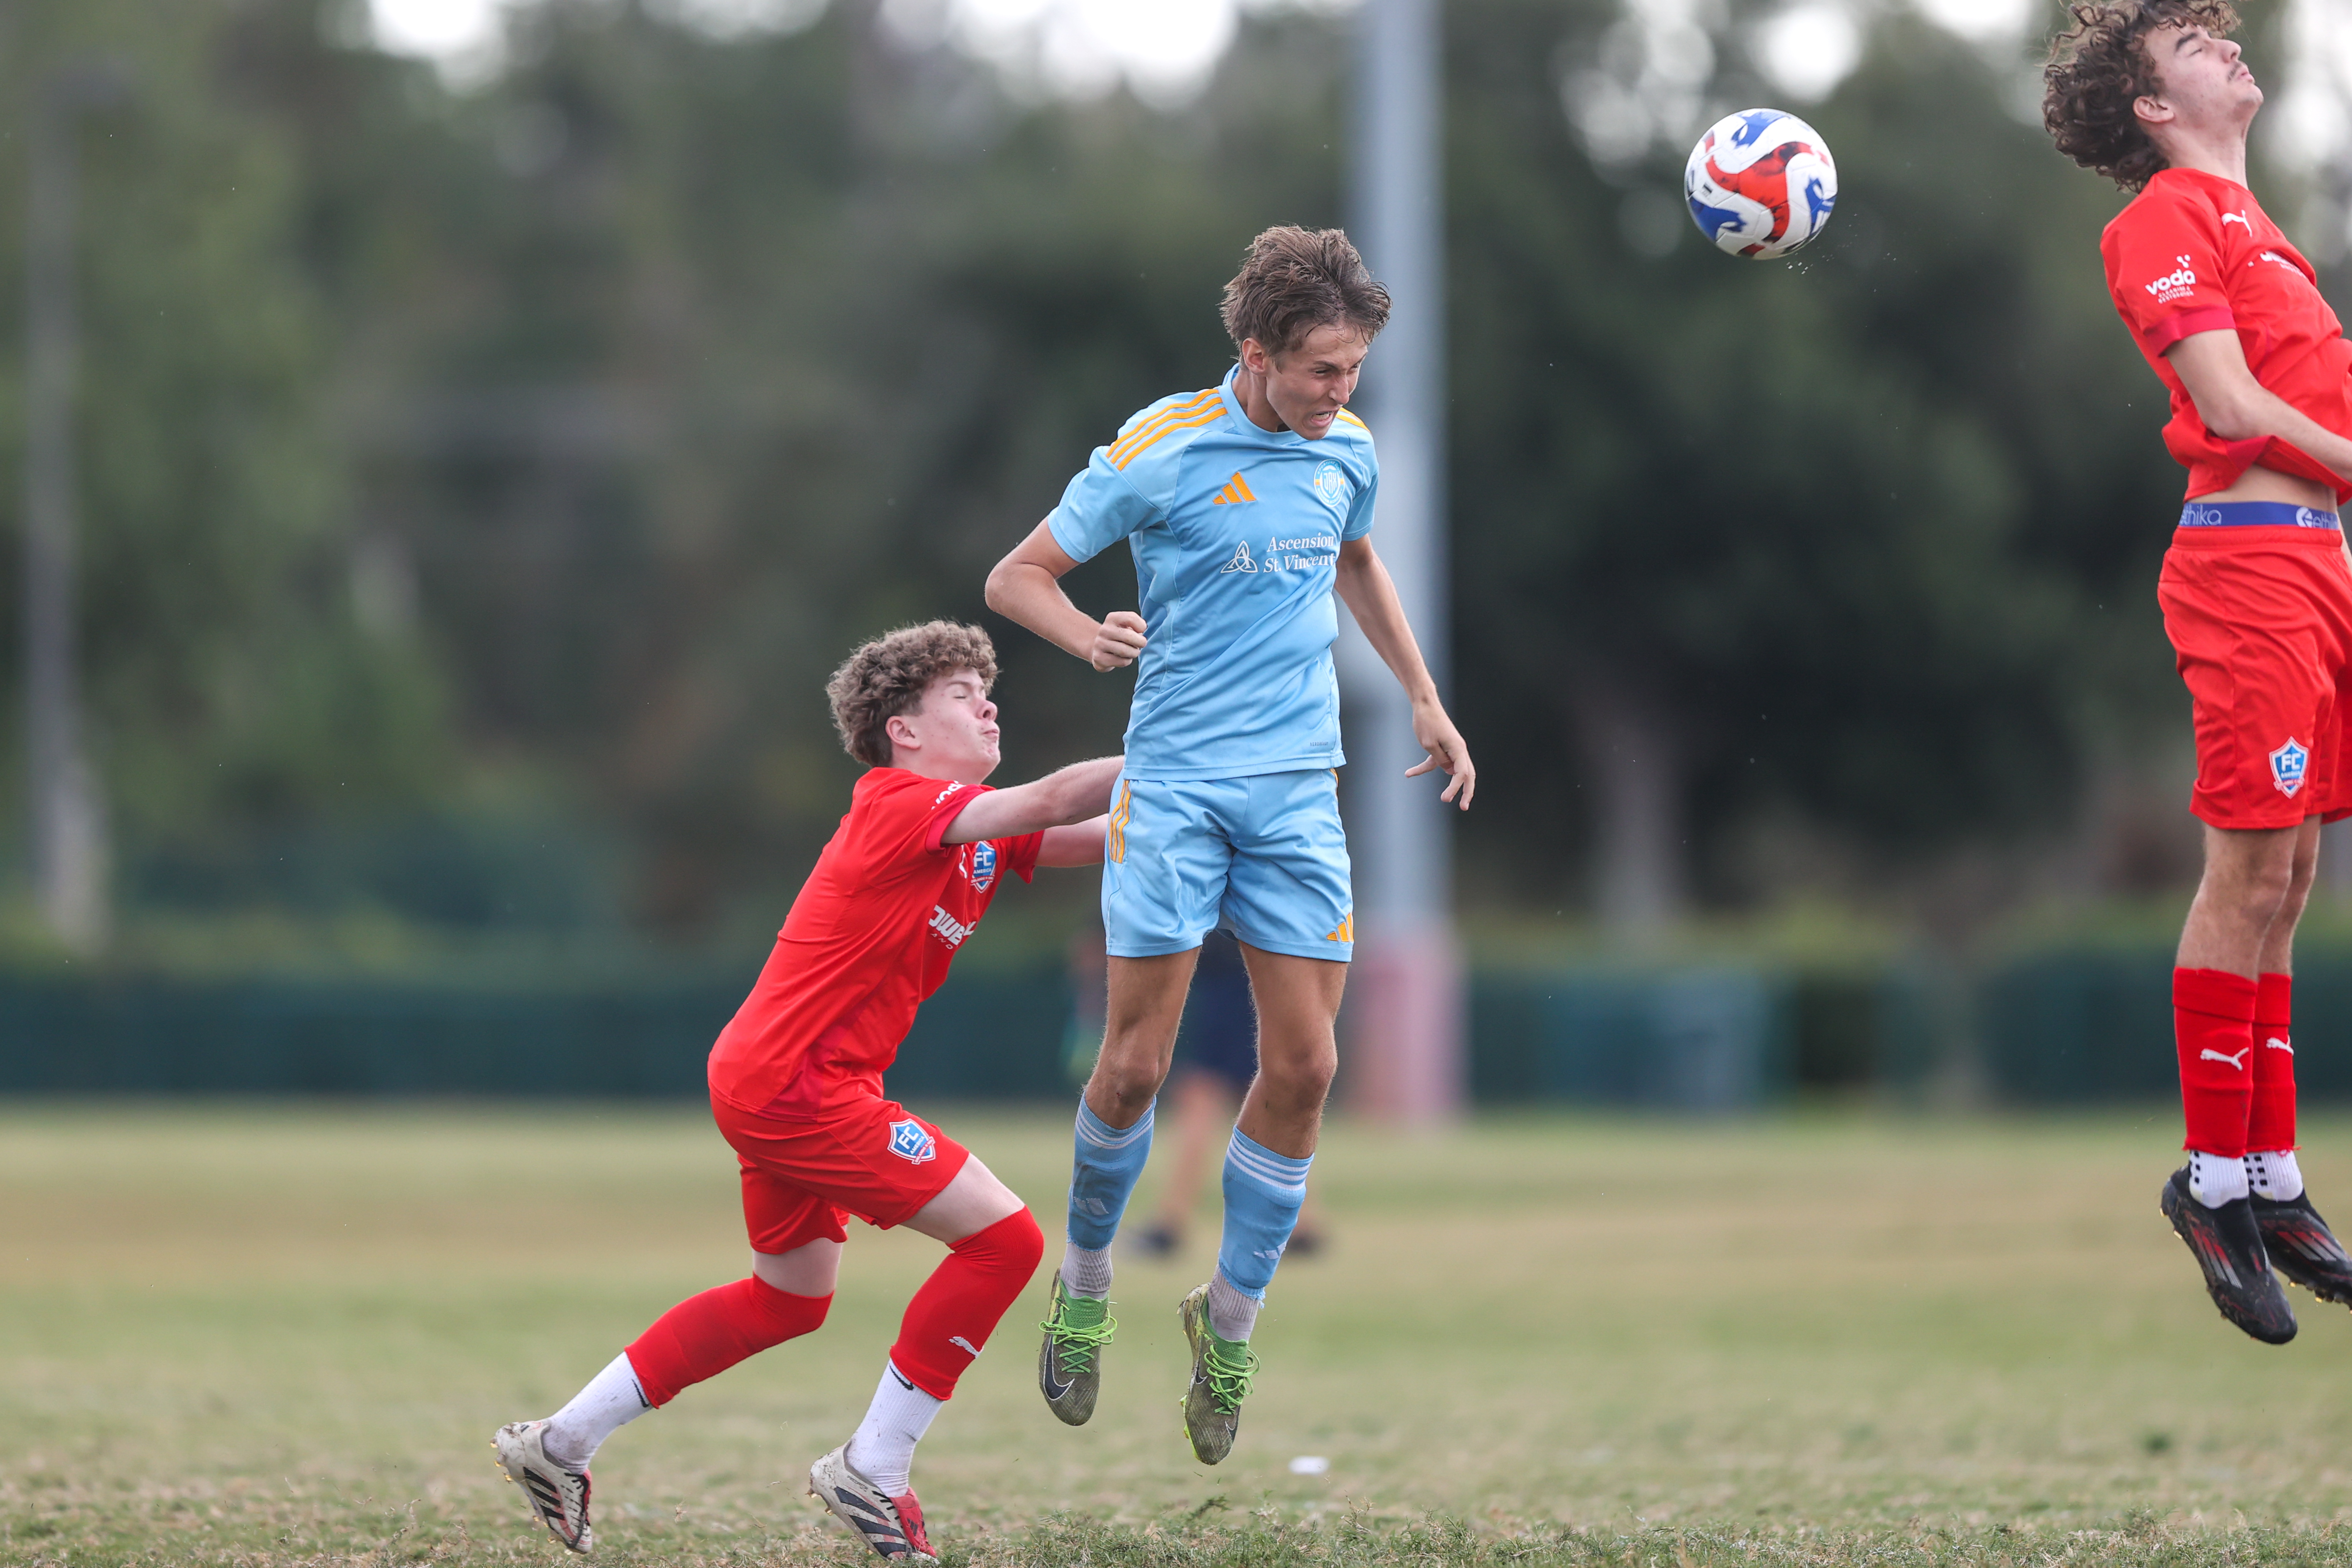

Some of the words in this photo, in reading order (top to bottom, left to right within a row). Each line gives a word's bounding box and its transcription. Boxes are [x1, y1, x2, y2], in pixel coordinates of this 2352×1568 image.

[2145, 269, 2196, 295] voda
[1323, 471, 1337, 494] JAX
[1266, 532, 1334, 552] Ascension
[1263, 558, 1282, 574] St.
[1283, 553, 1336, 570] Vincent
[2281, 753, 2302, 772] FC
[973, 851, 992, 867] FC
[897, 1126, 919, 1150] FC
[910, 1136, 925, 1155] AMERICA
